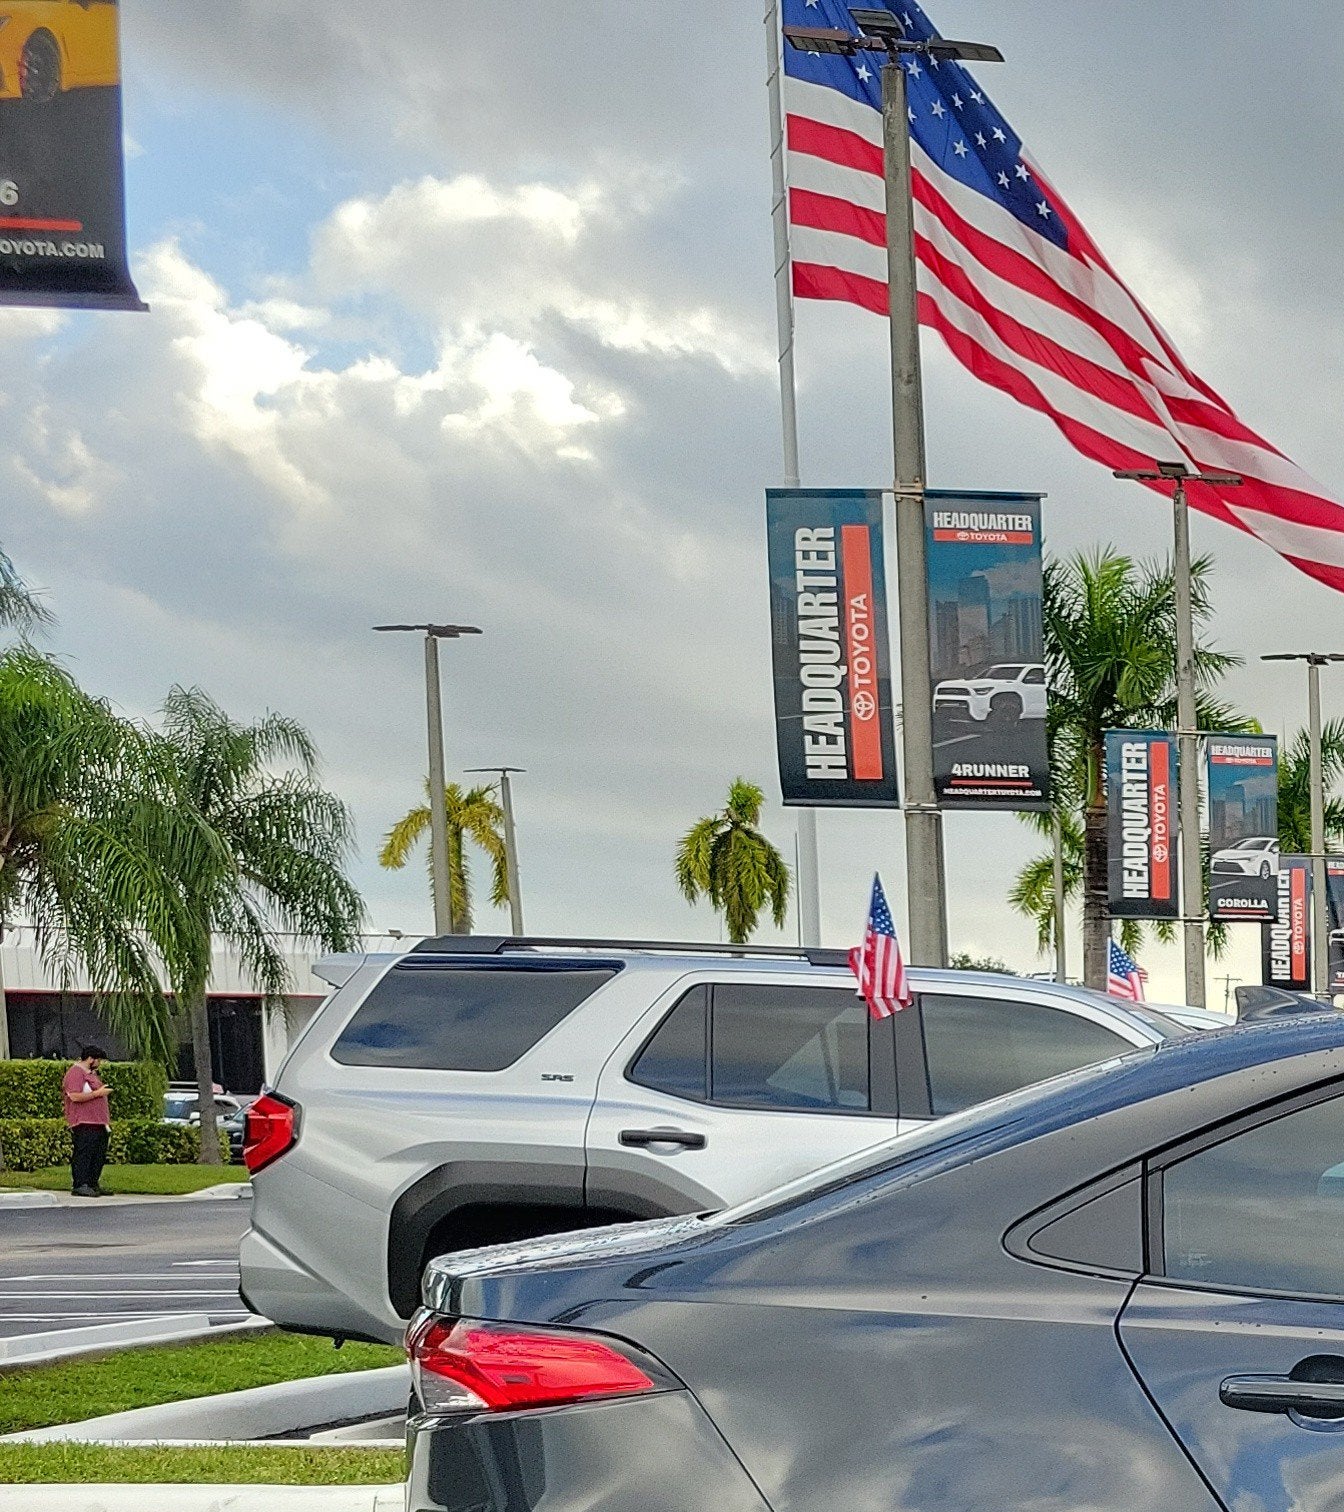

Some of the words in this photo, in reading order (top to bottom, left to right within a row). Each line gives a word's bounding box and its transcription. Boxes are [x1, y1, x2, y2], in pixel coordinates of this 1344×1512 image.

[933, 511, 1033, 531] HEADQUARTER
[971, 533, 1008, 542] TOYOTA
[795, 526, 848, 780] HEADQUARTER
[851, 593, 872, 689] TOYOTA
[951, 763, 1030, 778] 4RUNNER
[1122, 742, 1151, 899] HEADQUARTER
[1154, 784, 1169, 846] TOYOTA
[1217, 898, 1269, 908] COROLLA
[1293, 898, 1304, 941] TOYOTA
